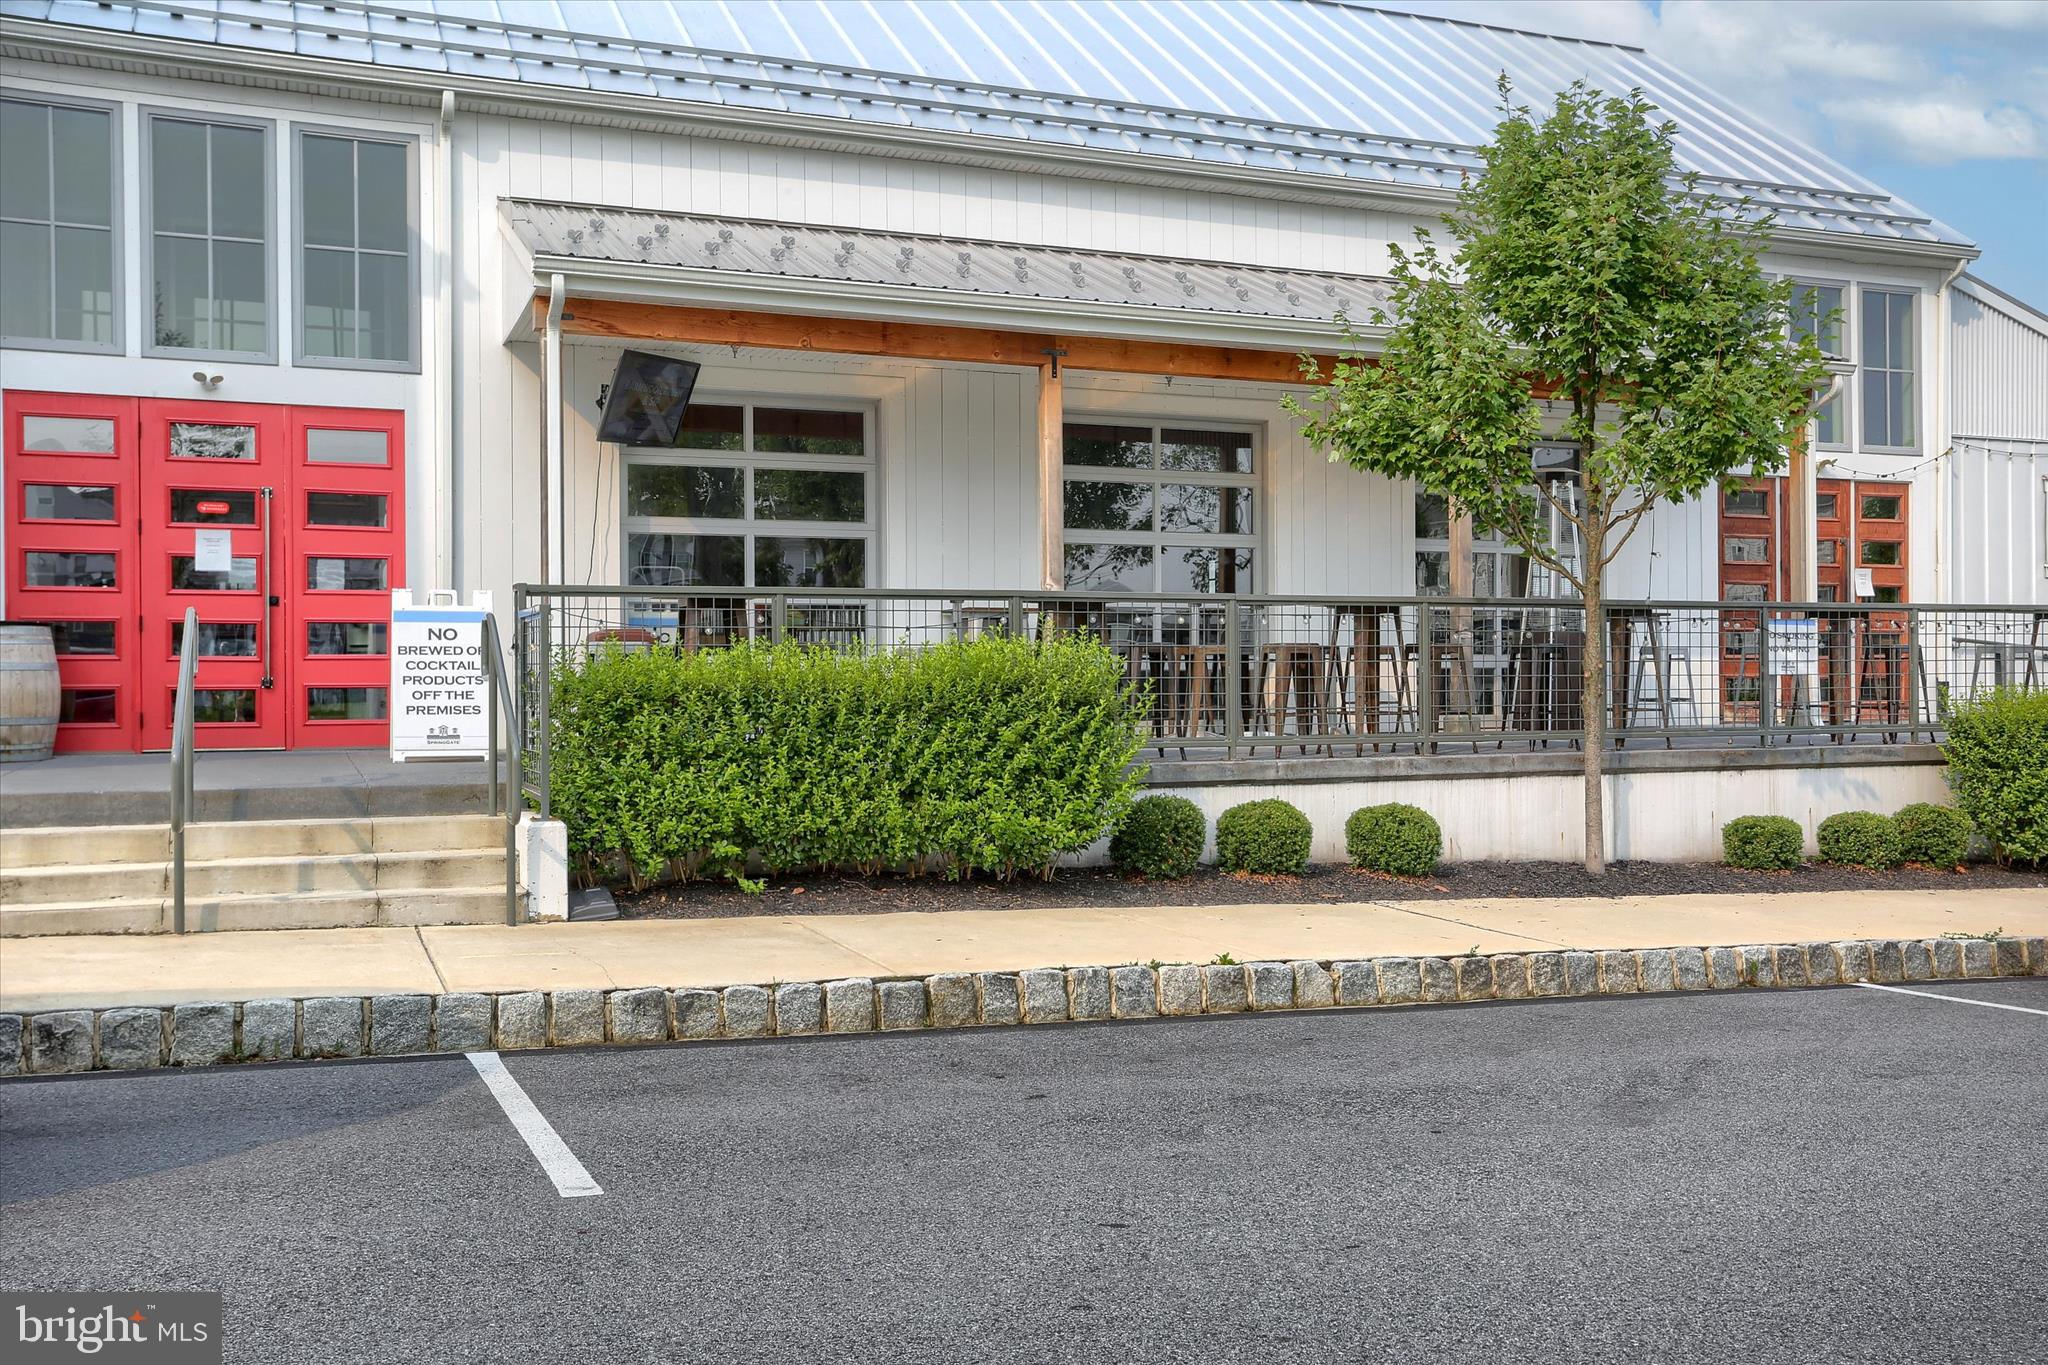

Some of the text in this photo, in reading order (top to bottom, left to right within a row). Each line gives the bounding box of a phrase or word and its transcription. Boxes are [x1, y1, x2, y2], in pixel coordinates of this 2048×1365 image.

[428, 628, 457, 640] NO
[398, 646, 463, 655] BREWED
[1780, 645, 1810, 653] VAPNG
[406, 661, 480, 670] COCKTAIL
[403, 675, 484, 685] PRODUCTS
[412, 691, 475, 700] OFF THE
[406, 705, 481, 715] PREMISES
